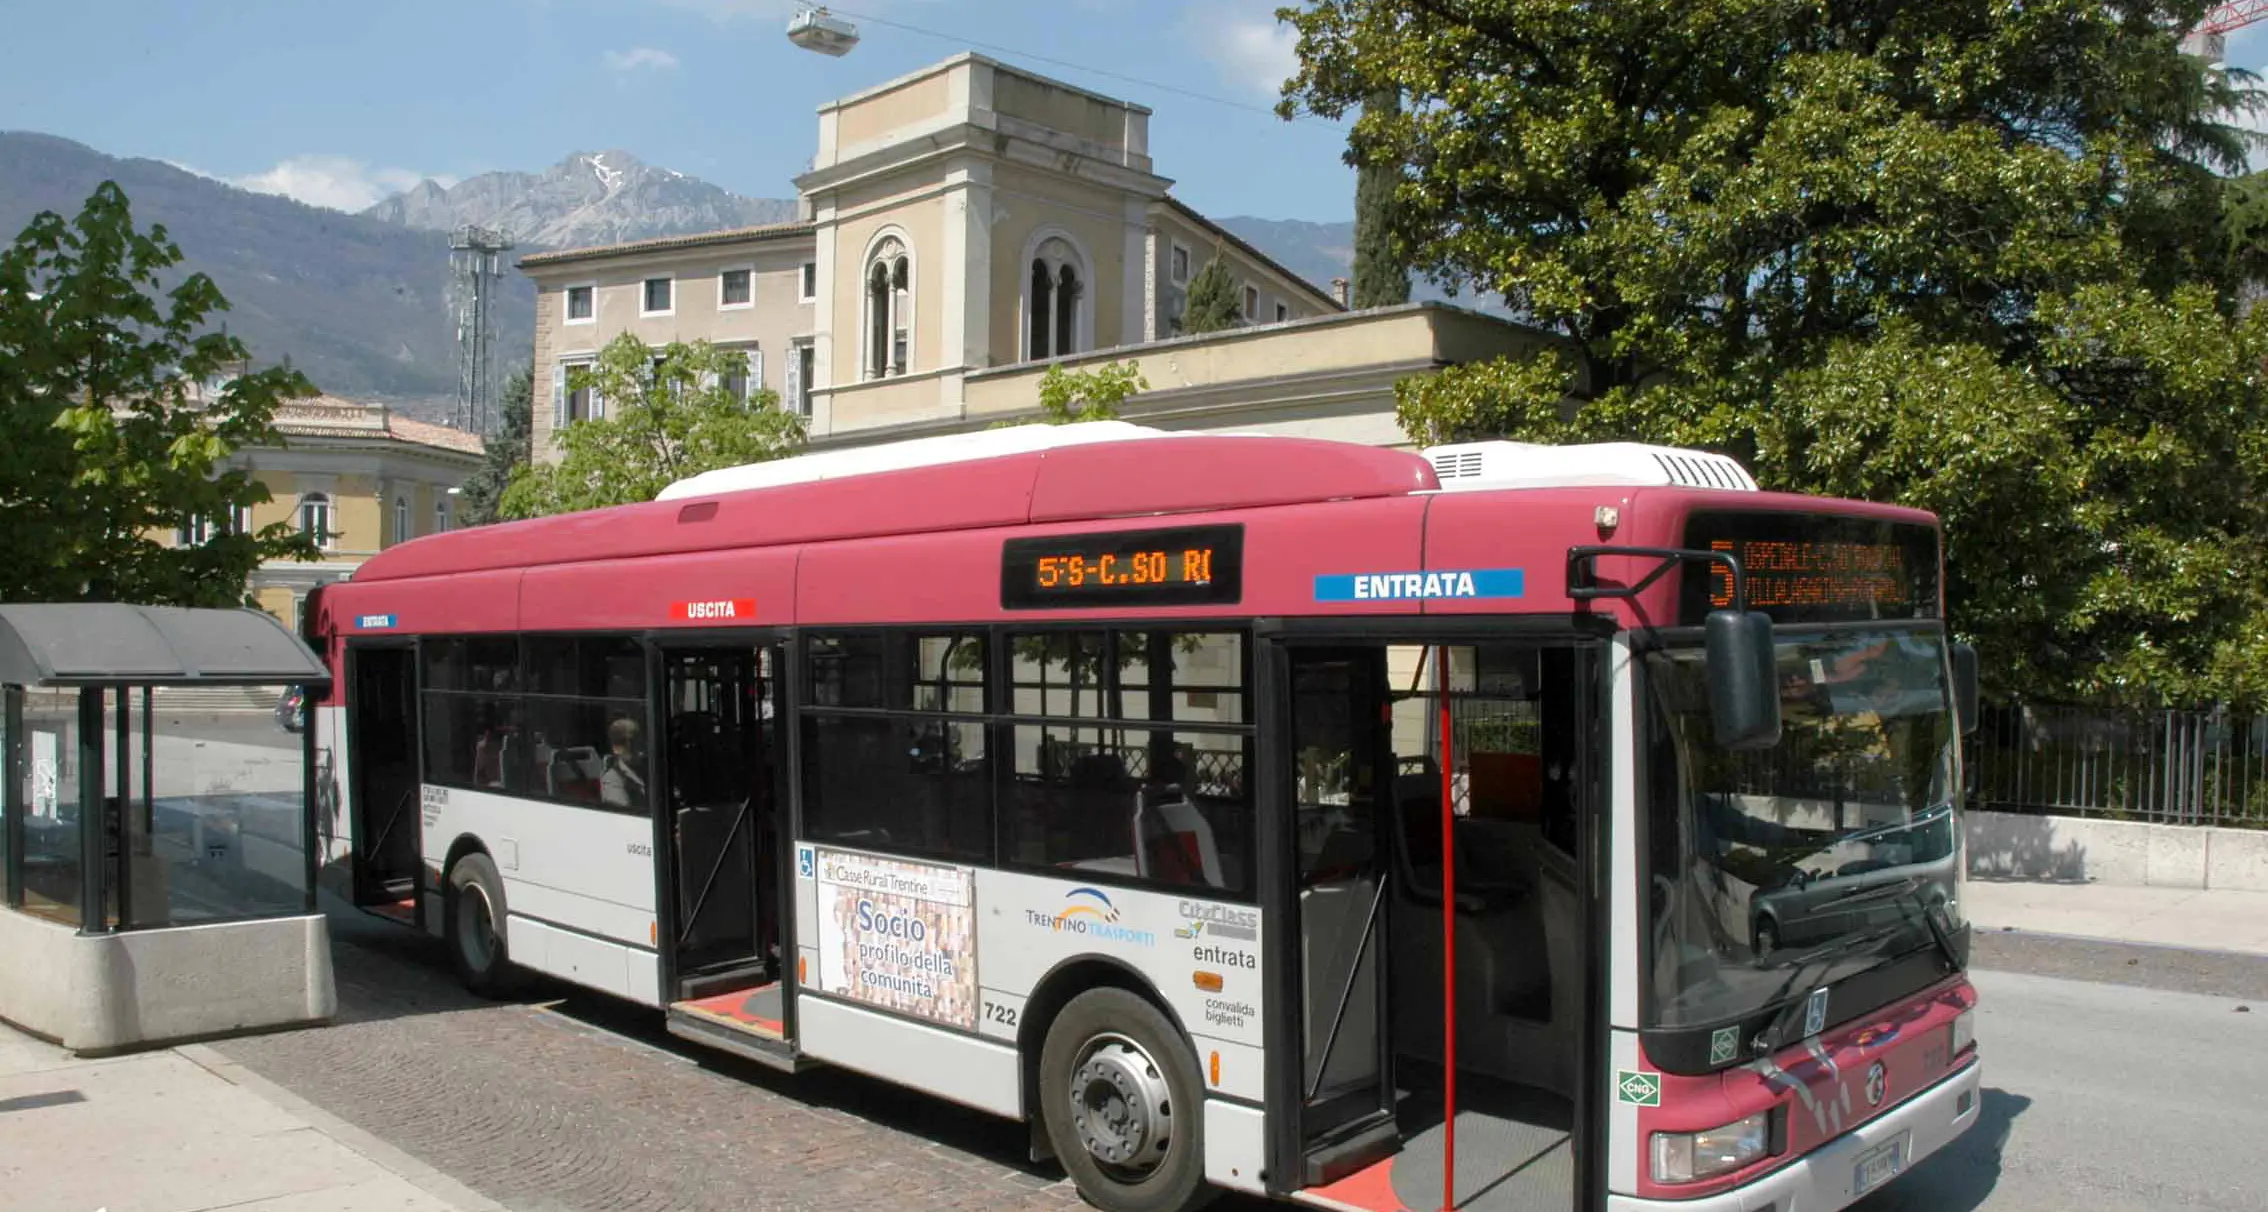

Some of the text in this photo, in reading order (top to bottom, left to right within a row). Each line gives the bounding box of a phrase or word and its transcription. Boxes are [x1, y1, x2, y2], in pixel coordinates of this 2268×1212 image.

[1354, 572, 1476, 599] ENTRATA
[687, 600, 736, 619] USCITA
[626, 843, 653, 858] uscita
[888, 873, 928, 895] Trentine
[858, 900, 925, 941] Socio
[859, 943, 952, 975] profilo della
[1193, 945, 1256, 969] entrata
[984, 1001, 1017, 1027] 722
[1205, 998, 1256, 1017] convalida
[1205, 1008, 1245, 1028] biglietti
[1626, 1081, 1651, 1095] CNG
